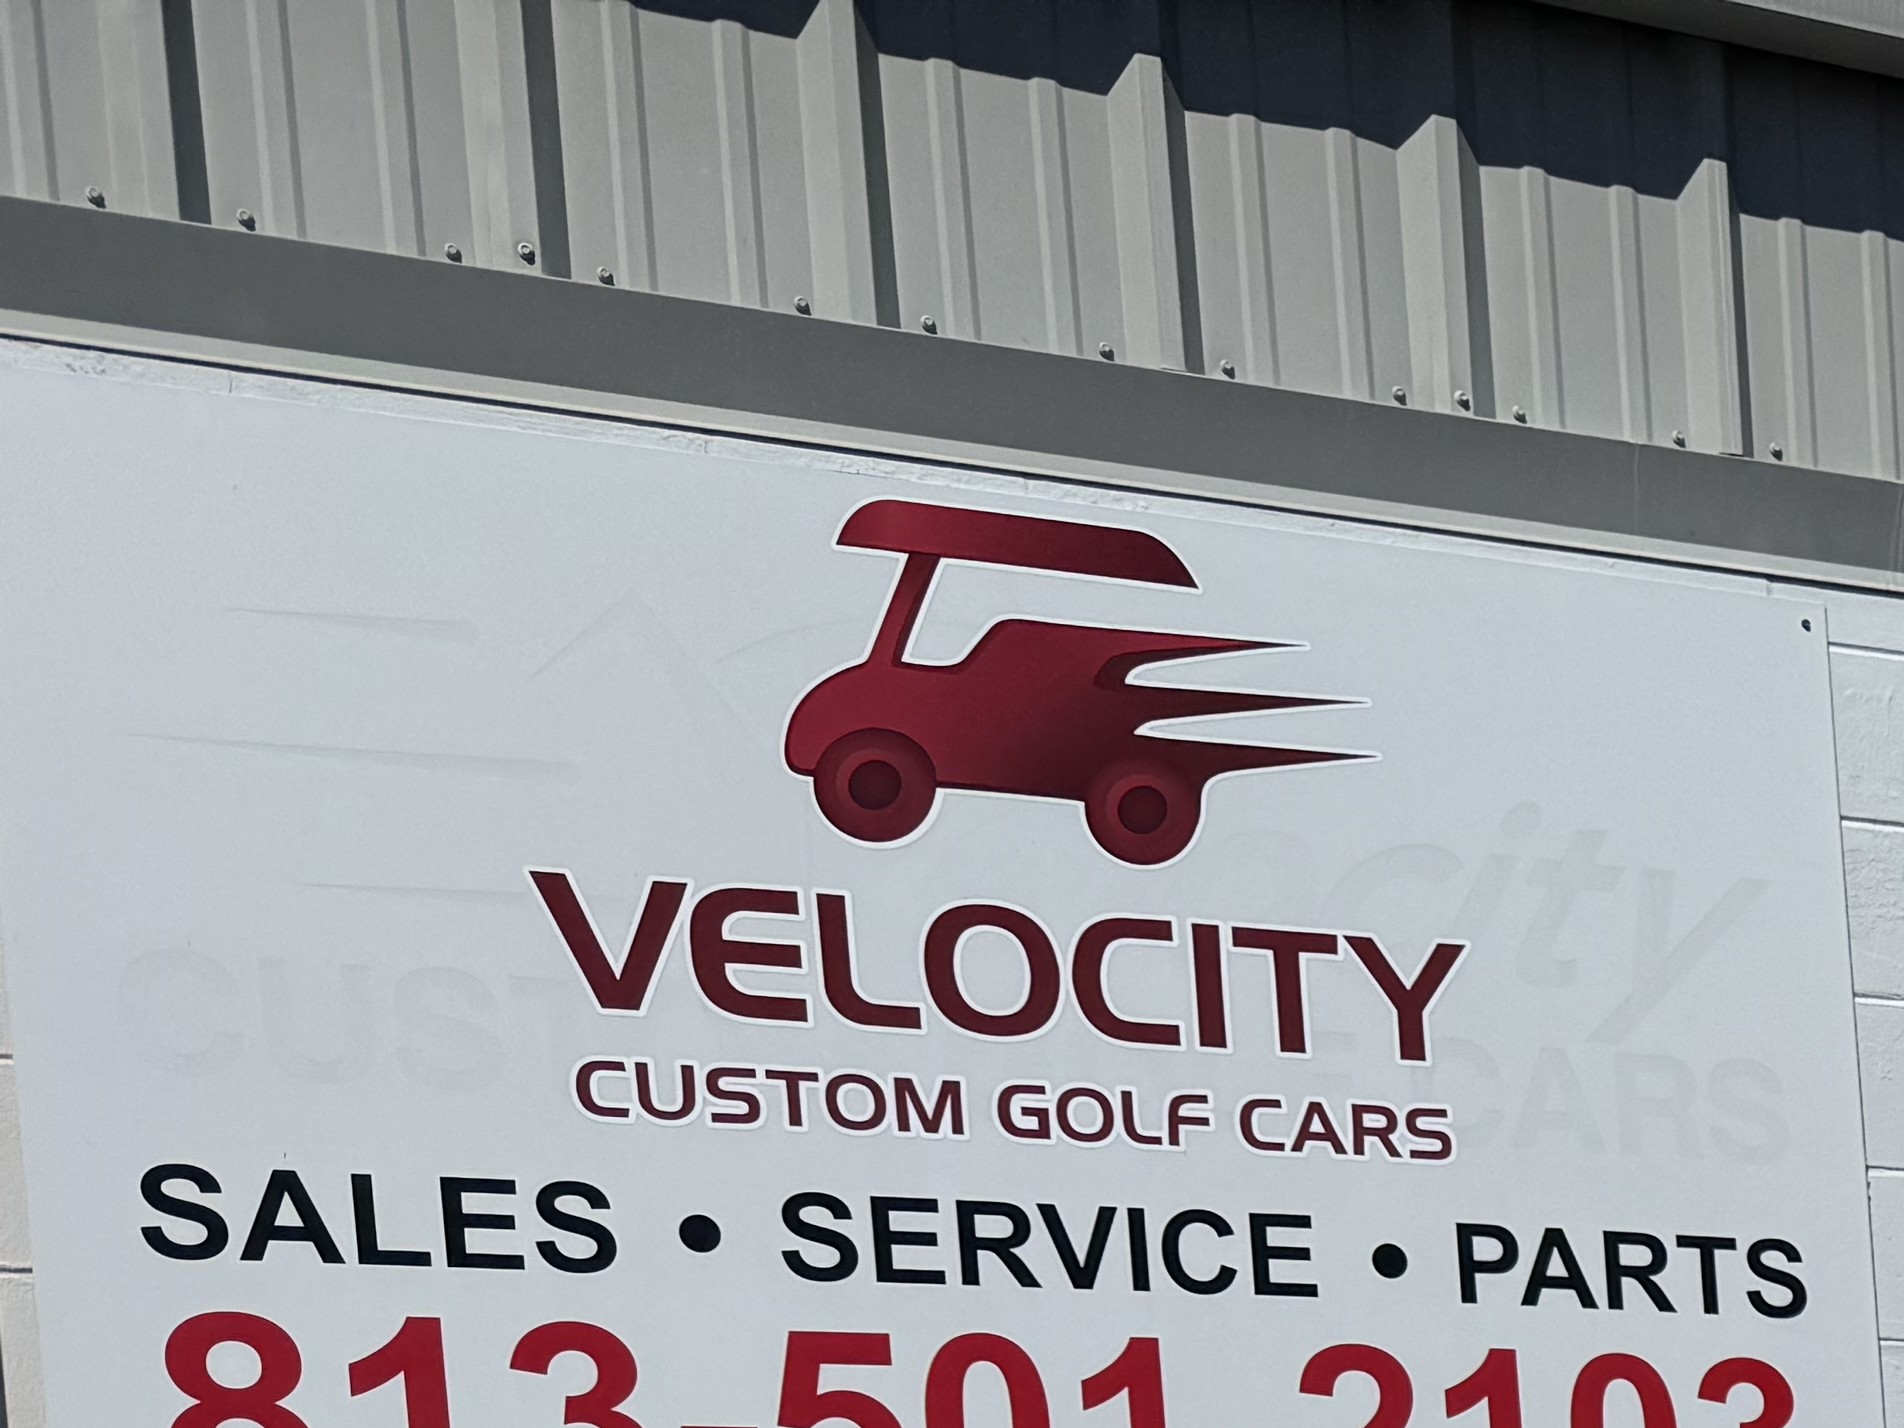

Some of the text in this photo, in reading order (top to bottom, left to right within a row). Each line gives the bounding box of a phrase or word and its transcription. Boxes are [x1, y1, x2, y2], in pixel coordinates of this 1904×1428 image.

[529, 871, 1465, 1061] VELOCITY
[575, 1059, 1453, 1162] CUSTOM GOLF CARS
[140, 1163, 1808, 1319] SALES SERVICE PARTS
